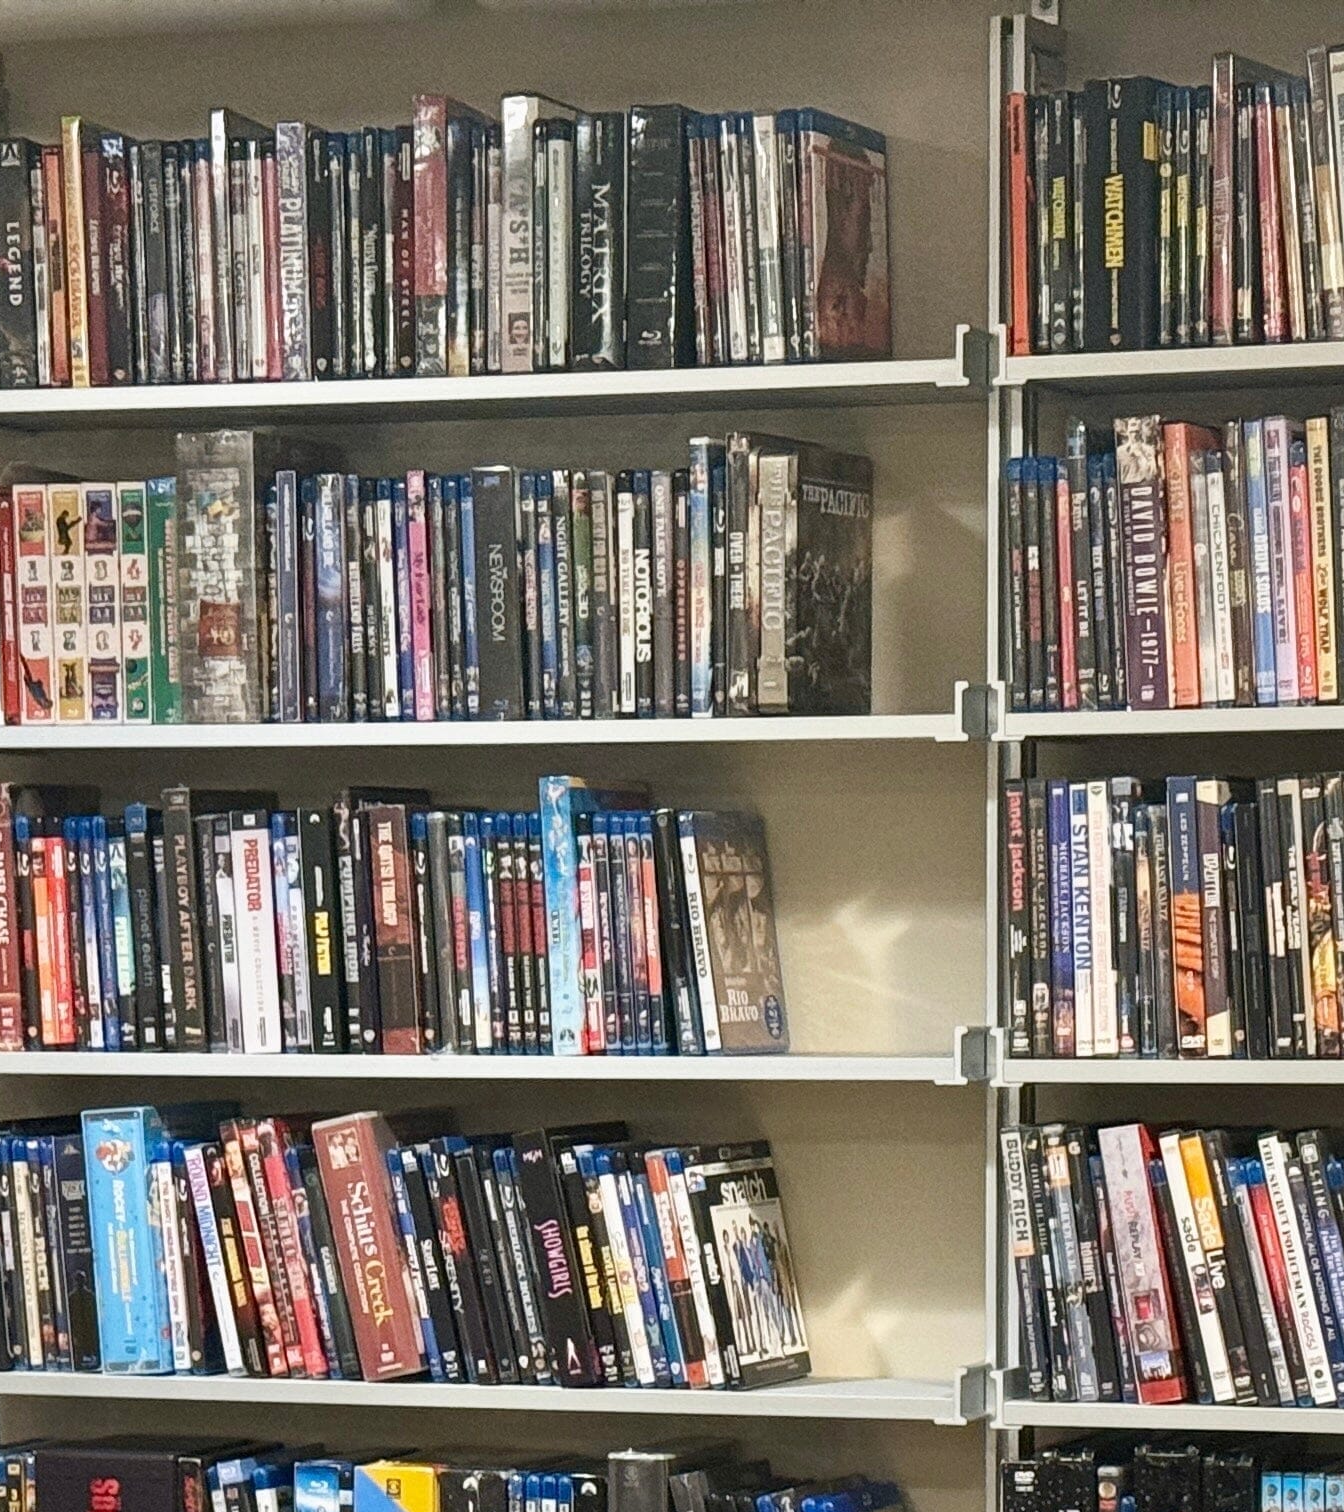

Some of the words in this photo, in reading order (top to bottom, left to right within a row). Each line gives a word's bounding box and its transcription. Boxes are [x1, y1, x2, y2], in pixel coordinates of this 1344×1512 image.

[1053, 176, 1066, 239] WATCHMEN
[1105, 174, 1123, 268] WATCHMEN
[6, 221, 22, 306] LEGEND
[281, 198, 302, 297] PLATINUM
[580, 211, 593, 300] TRILOGY
[591, 182, 612, 323] MATRIX
[1130, 486, 1155, 542] DAVID
[730, 532, 744, 563] OVER
[761, 508, 788, 631] PACIFIC
[1212, 504, 1225, 613] CHICKENFOOT
[489, 544, 505, 641] NEWSROOM
[635, 549, 652, 662] NOTORIOUS
[730, 571, 744, 610] THERE
[1133, 555, 1157, 616] BOWIE
[1141, 631, 1158, 665] 1977
[1007, 790, 1024, 837] janet
[173, 835, 189, 905] PLAYBOY
[244, 839, 261, 911] PREDATOR
[1008, 843, 1026, 912] jackson
[1071, 823, 1088, 878] STAN
[179, 910, 194, 962] AFTER
[689, 892, 701, 920] RIO
[1073, 887, 1090, 971] KENTON
[692, 925, 707, 978] BRAVO
[184, 966, 196, 1010] DARK
[719, 1004, 758, 1022] BRAVO
[726, 989, 748, 1006] RIO
[1006, 1139, 1025, 1192] BUDDY
[1307, 1170, 1328, 1218] STING
[679, 1214, 700, 1288] SKYFALL
[1011, 1201, 1029, 1242] RICH
[1182, 1216, 1196, 1252] sade
[1195, 1198, 1218, 1248] Sade
[1208, 1251, 1227, 1290] Live
[438, 1230, 464, 1314] SERENITY
[534, 1219, 573, 1298] SHOWGIRLS
